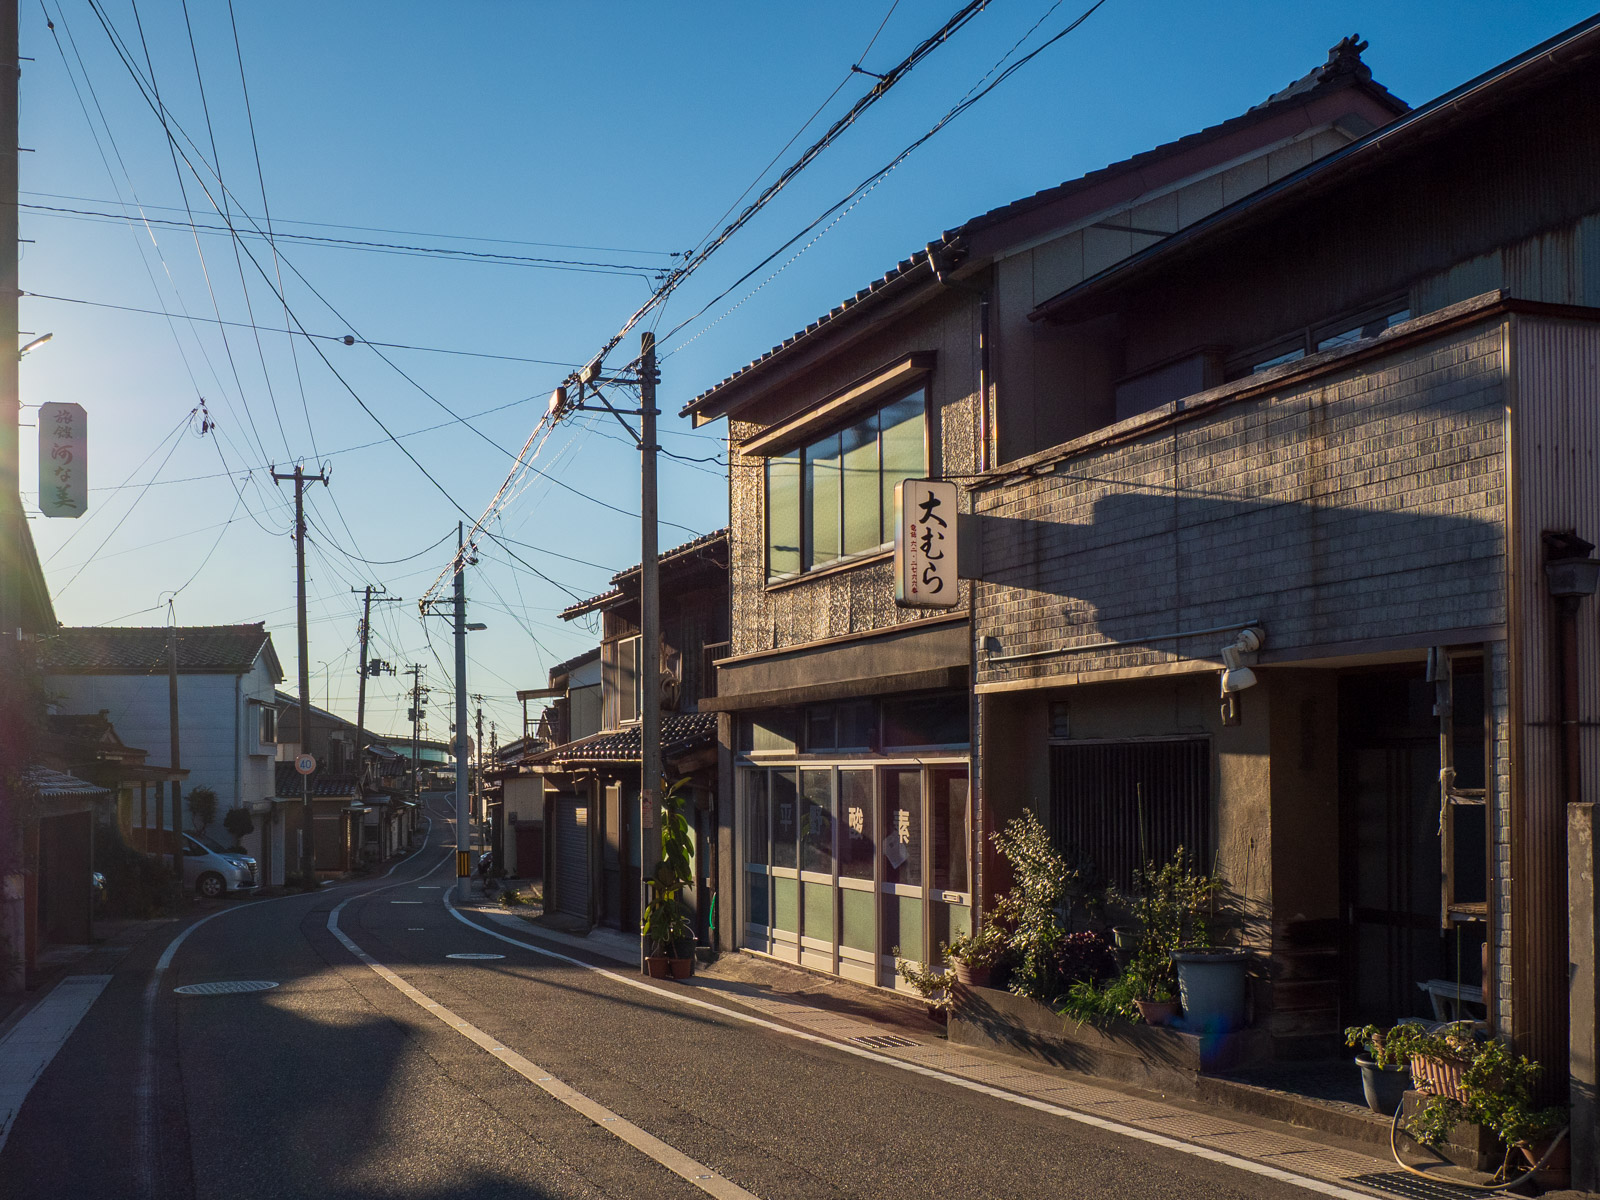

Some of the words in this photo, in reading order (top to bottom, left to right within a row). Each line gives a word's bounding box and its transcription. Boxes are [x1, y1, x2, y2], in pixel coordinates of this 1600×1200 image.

[918, 490, 948, 594] 大むら
[299, 759, 312, 769] 40
